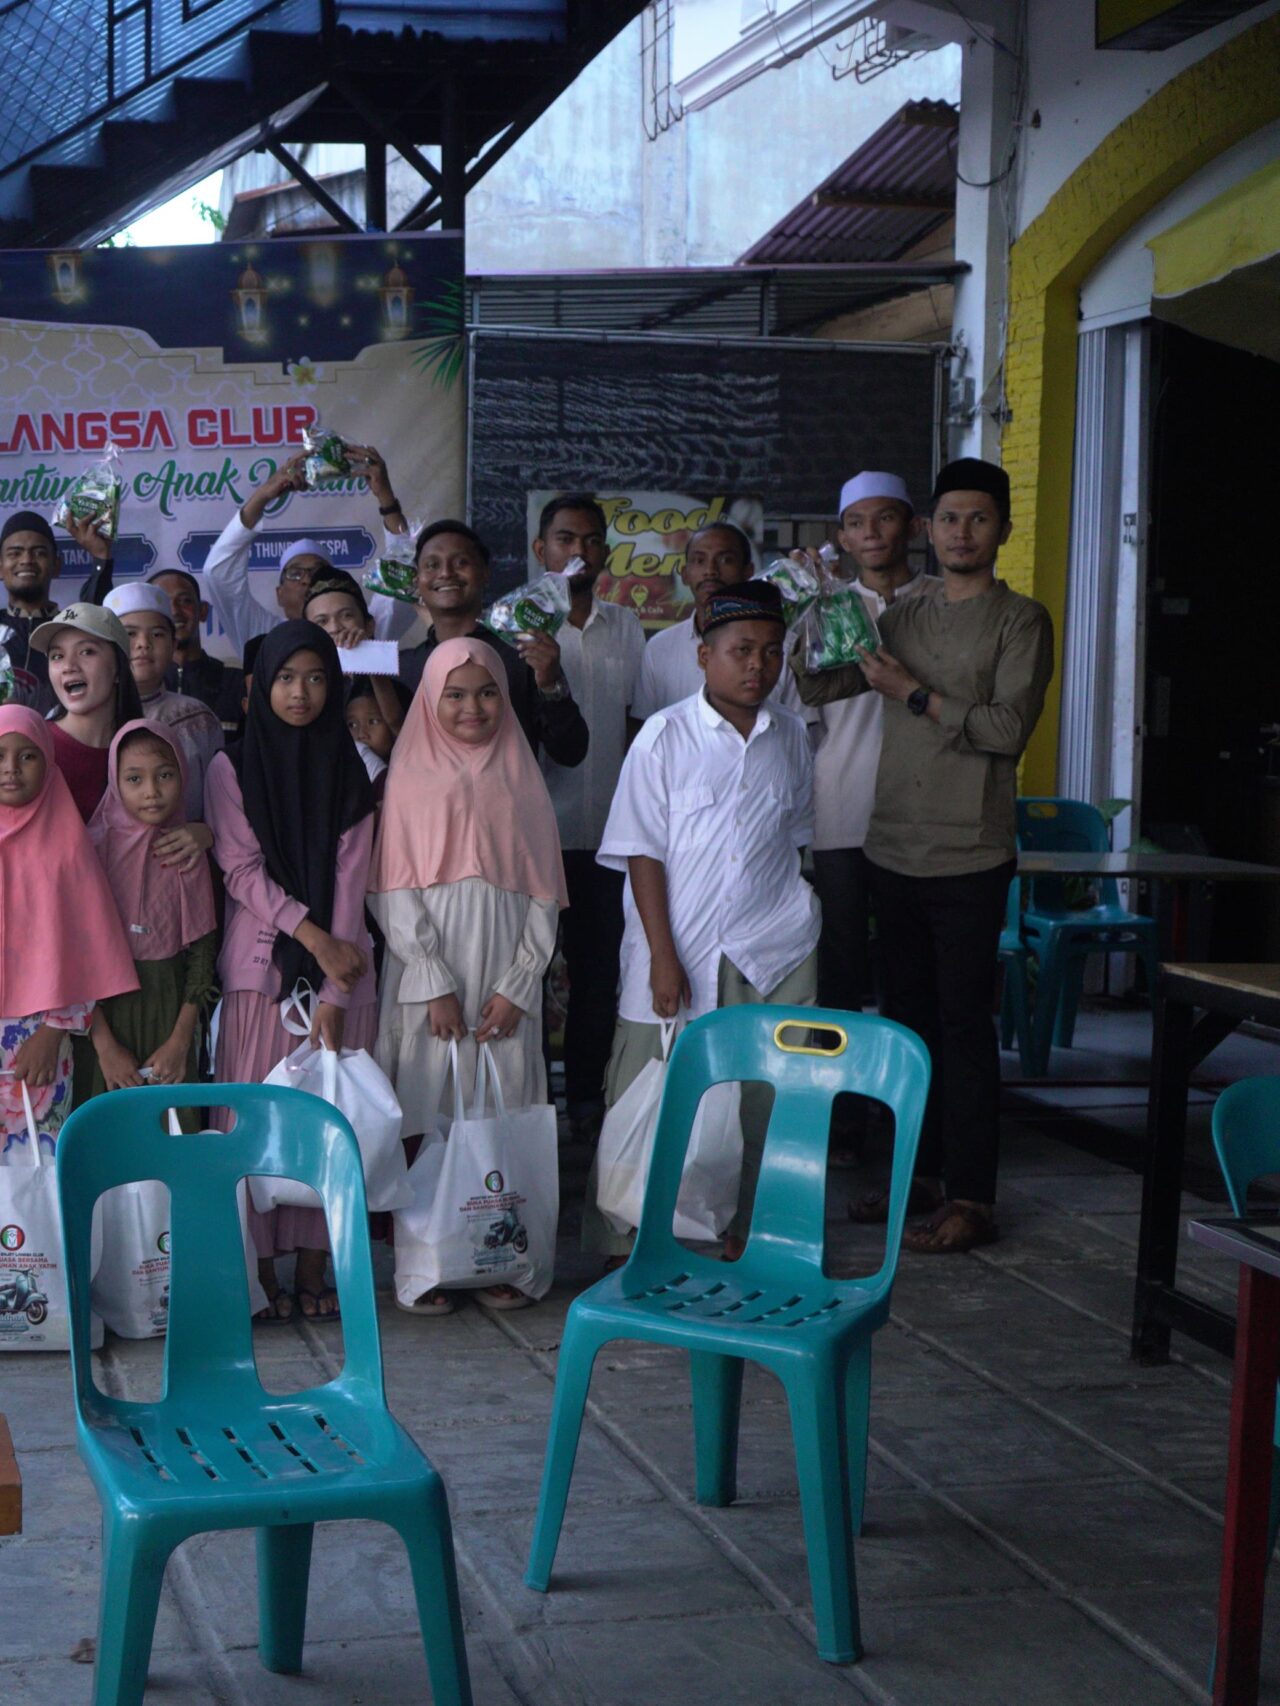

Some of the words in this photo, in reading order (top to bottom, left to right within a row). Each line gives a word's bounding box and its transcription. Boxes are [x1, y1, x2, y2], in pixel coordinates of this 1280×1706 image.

[188, 406, 315, 447] CLUB
[134, 453, 244, 515] Anak
[593, 496, 726, 535] Food
